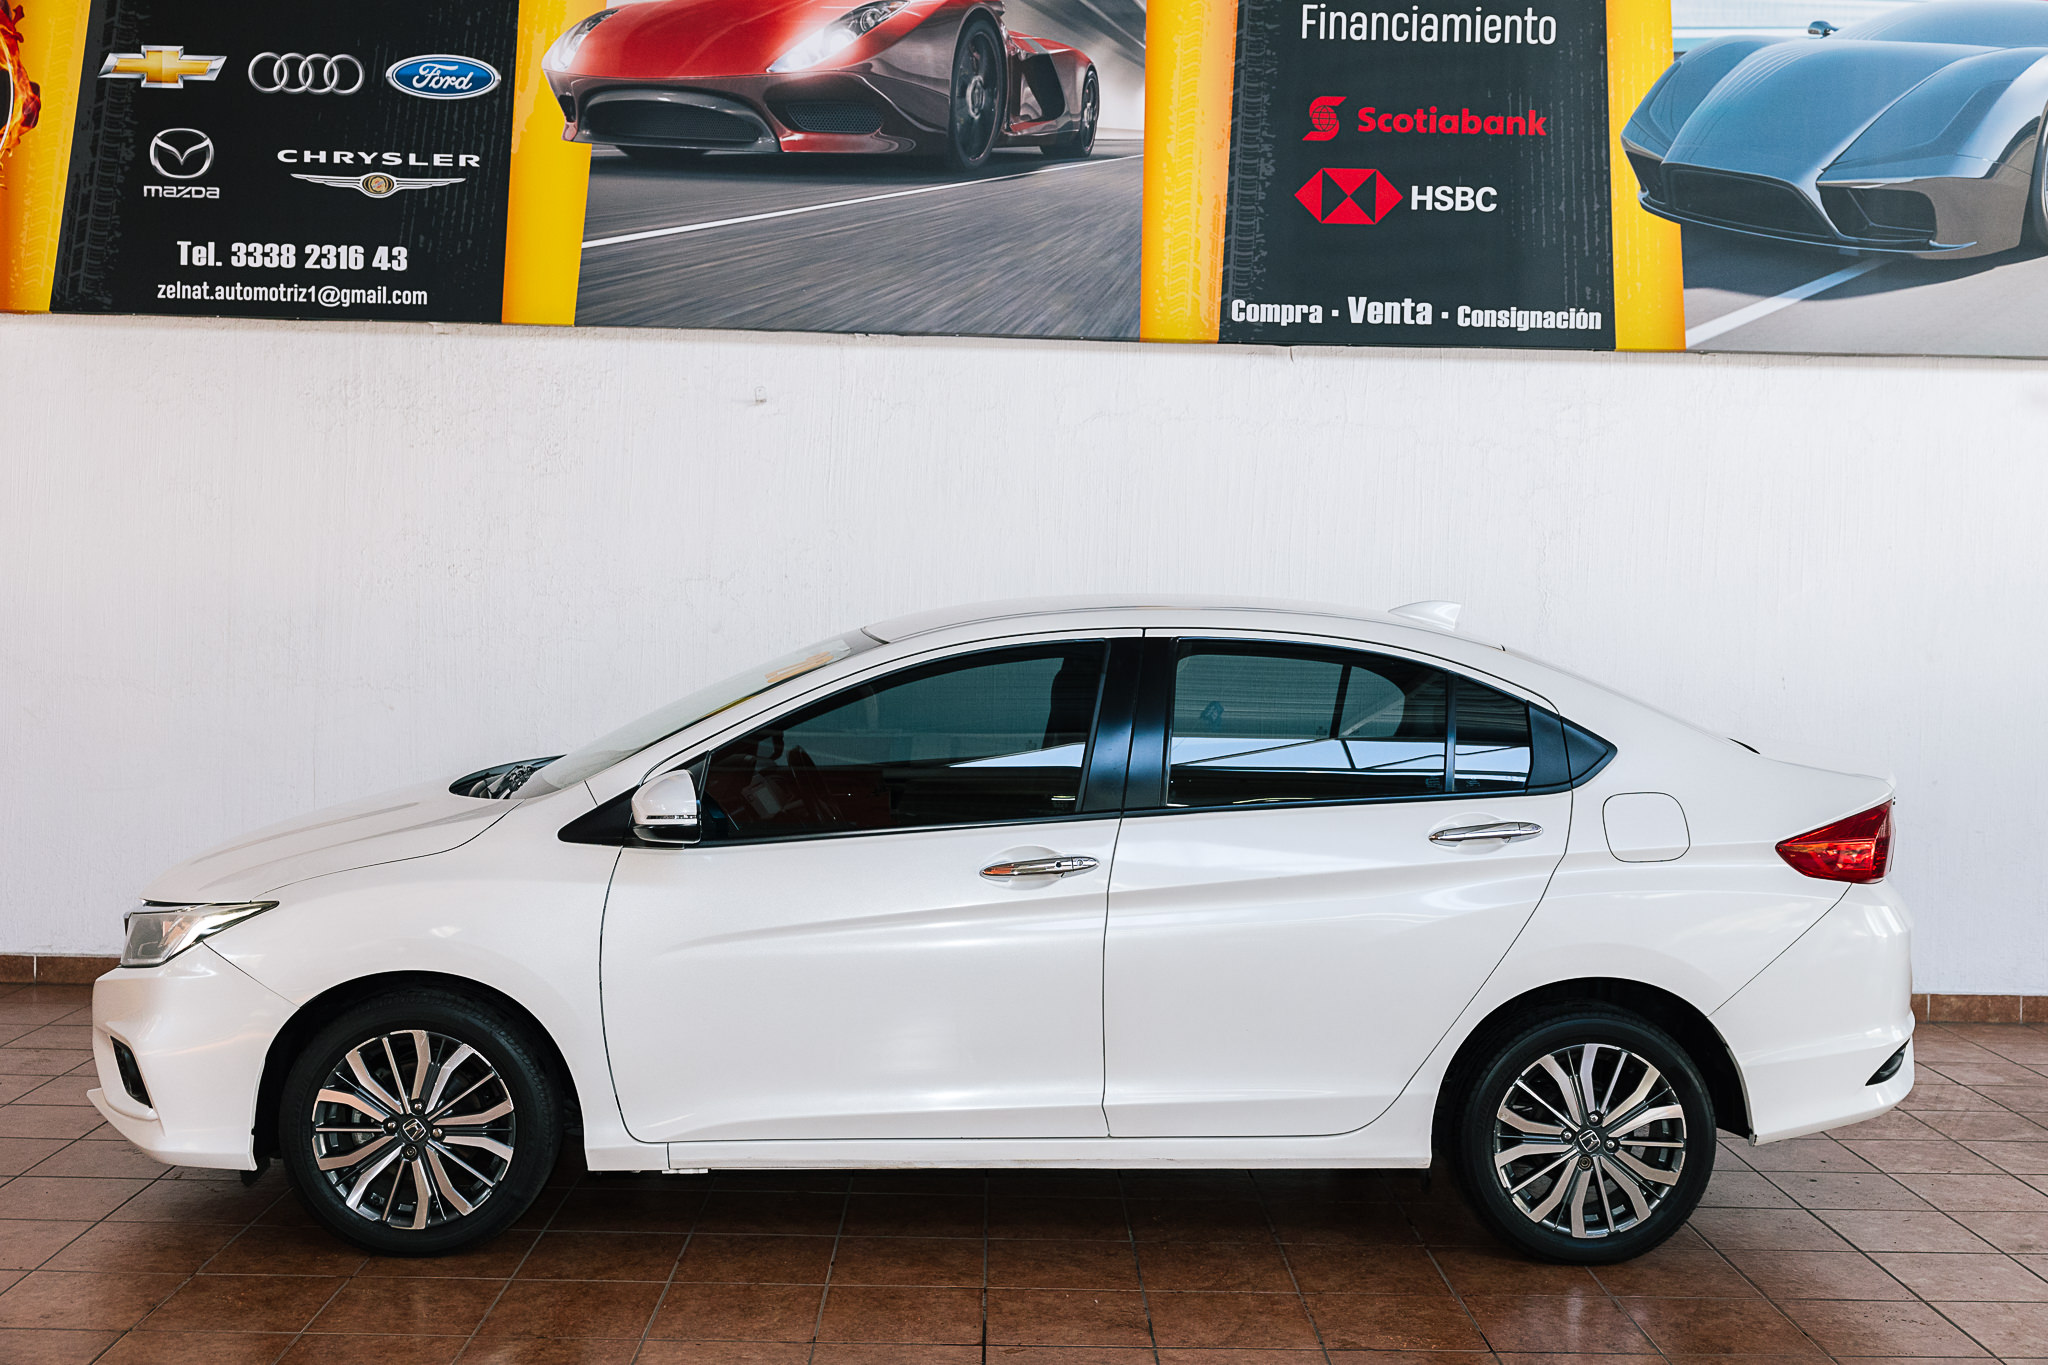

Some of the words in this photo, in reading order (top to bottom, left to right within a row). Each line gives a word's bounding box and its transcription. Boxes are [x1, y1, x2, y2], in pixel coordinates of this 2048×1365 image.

[1301, 3, 1557, 46] Financiamiento
[411, 62, 474, 91] Ford
[1357, 105, 1547, 136] Scotiabank
[277, 149, 480, 168] CHRYSLER
[143, 185, 220, 199] mazda
[1410, 185, 1498, 213] HSBC
[176, 240, 223, 267] Tel.
[230, 242, 296, 269] 3338
[304, 244, 365, 270] 2316
[371, 245, 408, 272] 43
[157, 280, 428, 308] zelnat.automotriz1@gmail.com
[1231, 298, 1323, 326] Compra
[1347, 296, 1433, 325] Venta
[1457, 305, 1602, 332] Consignación
